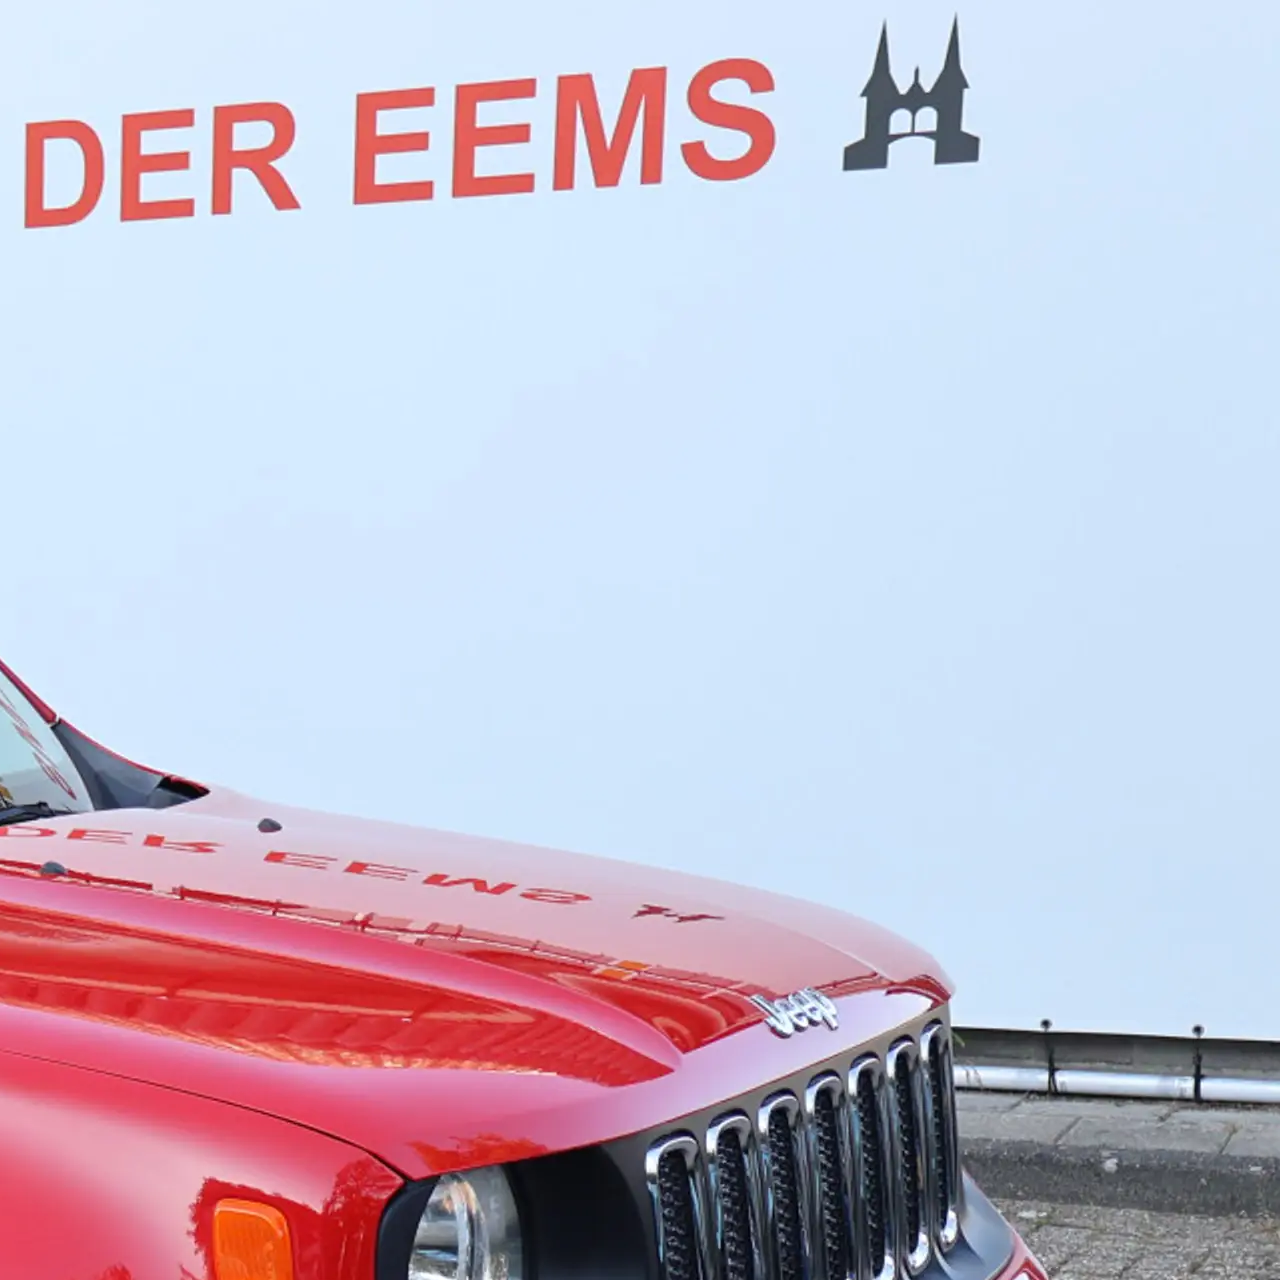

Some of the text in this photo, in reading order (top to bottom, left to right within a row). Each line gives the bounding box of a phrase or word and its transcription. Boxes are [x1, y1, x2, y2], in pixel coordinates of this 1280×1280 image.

[23, 101, 301, 230] DER
[352, 57, 777, 206] EEMS
[750, 986, 839, 1039] Jeep
